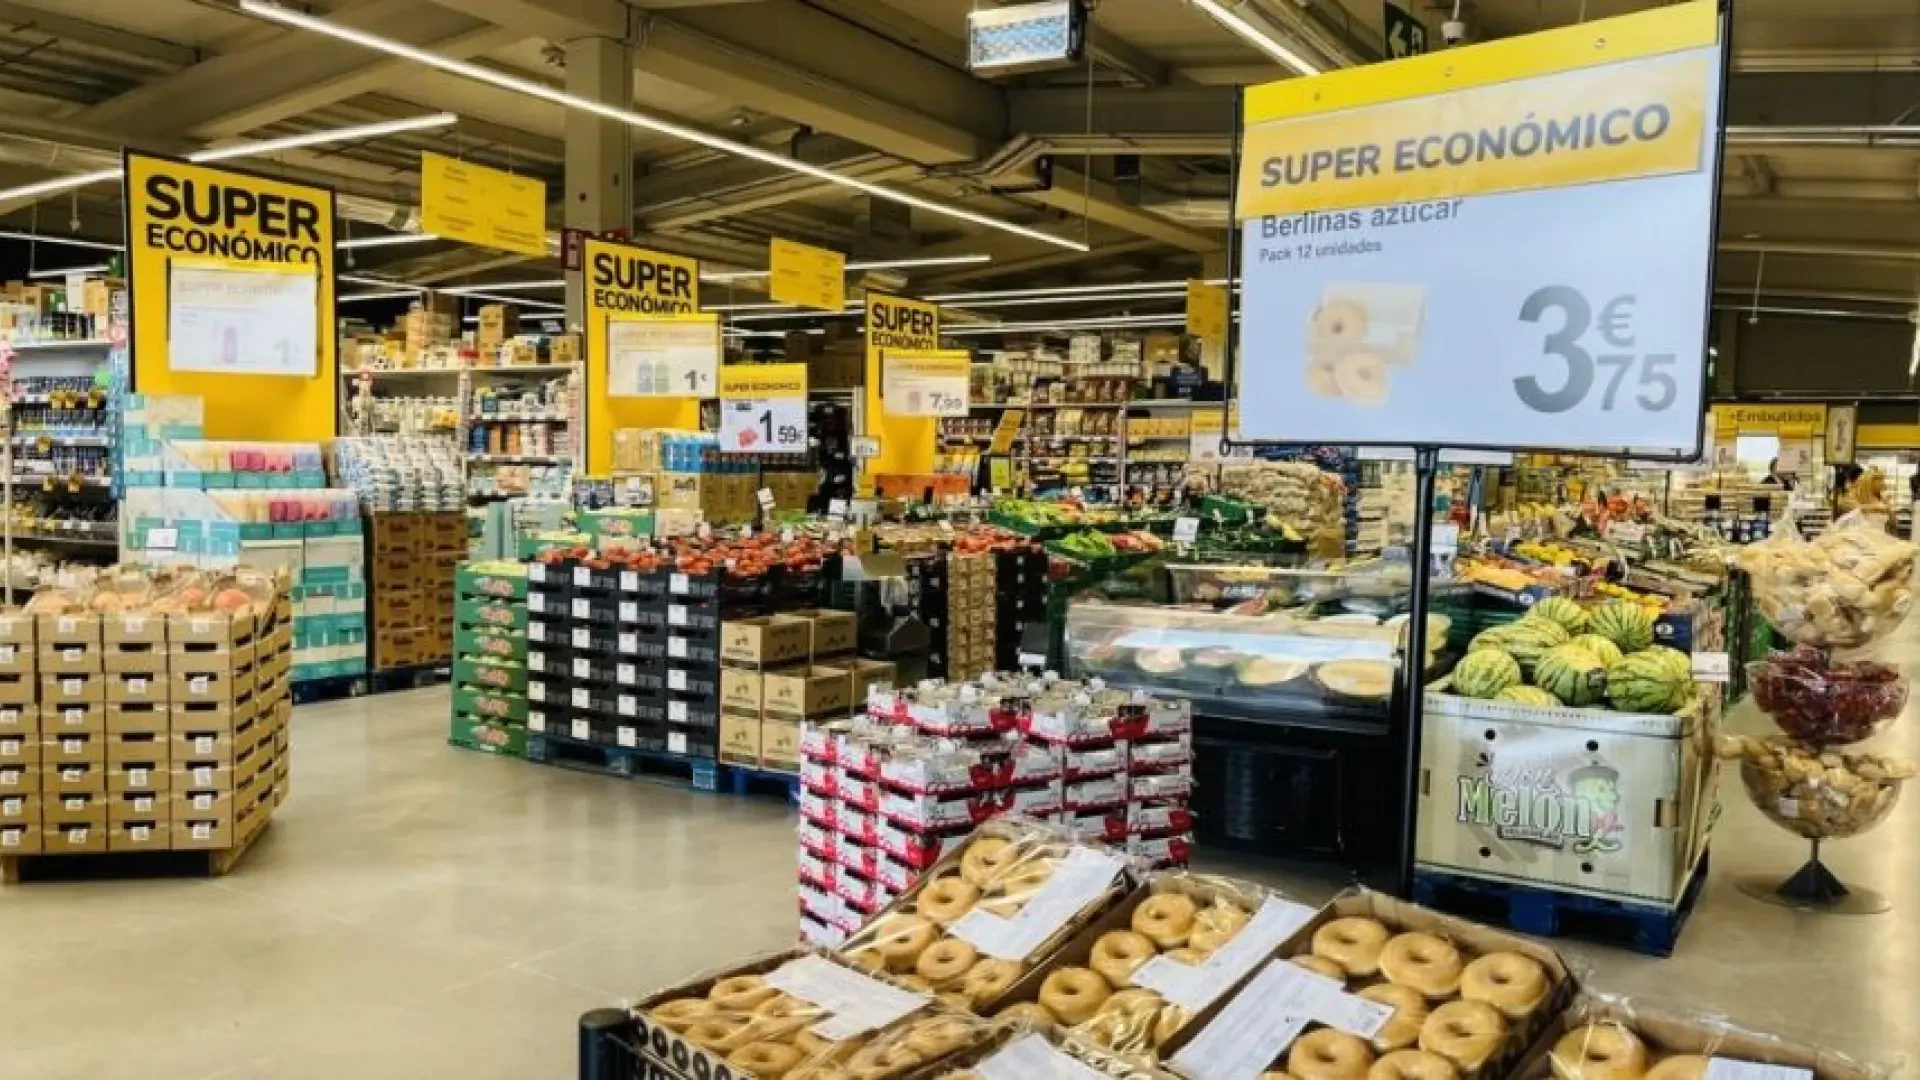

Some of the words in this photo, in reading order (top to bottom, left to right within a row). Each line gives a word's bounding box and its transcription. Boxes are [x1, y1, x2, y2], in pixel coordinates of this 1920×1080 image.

[1260, 143, 1381, 188] SUPER
[1393, 102, 1671, 172] ECONÓMICO
[145, 174, 320, 243] SUPER
[1261, 209, 1362, 239] Berlinas
[1370, 197, 1464, 228] azúcar
[146, 223, 322, 264] ECONÓMICO
[1258, 247, 1292, 263] Pack
[1297, 243, 1314, 260] 12
[1315, 239, 1384, 258] unidades
[594, 252, 692, 299] SUPER
[872, 302, 934, 336] SUPER
[1512, 284, 1595, 413] 3
[1597, 293, 1636, 347] €
[1597, 353, 1678, 412] 75
[759, 409, 772, 444] 1
